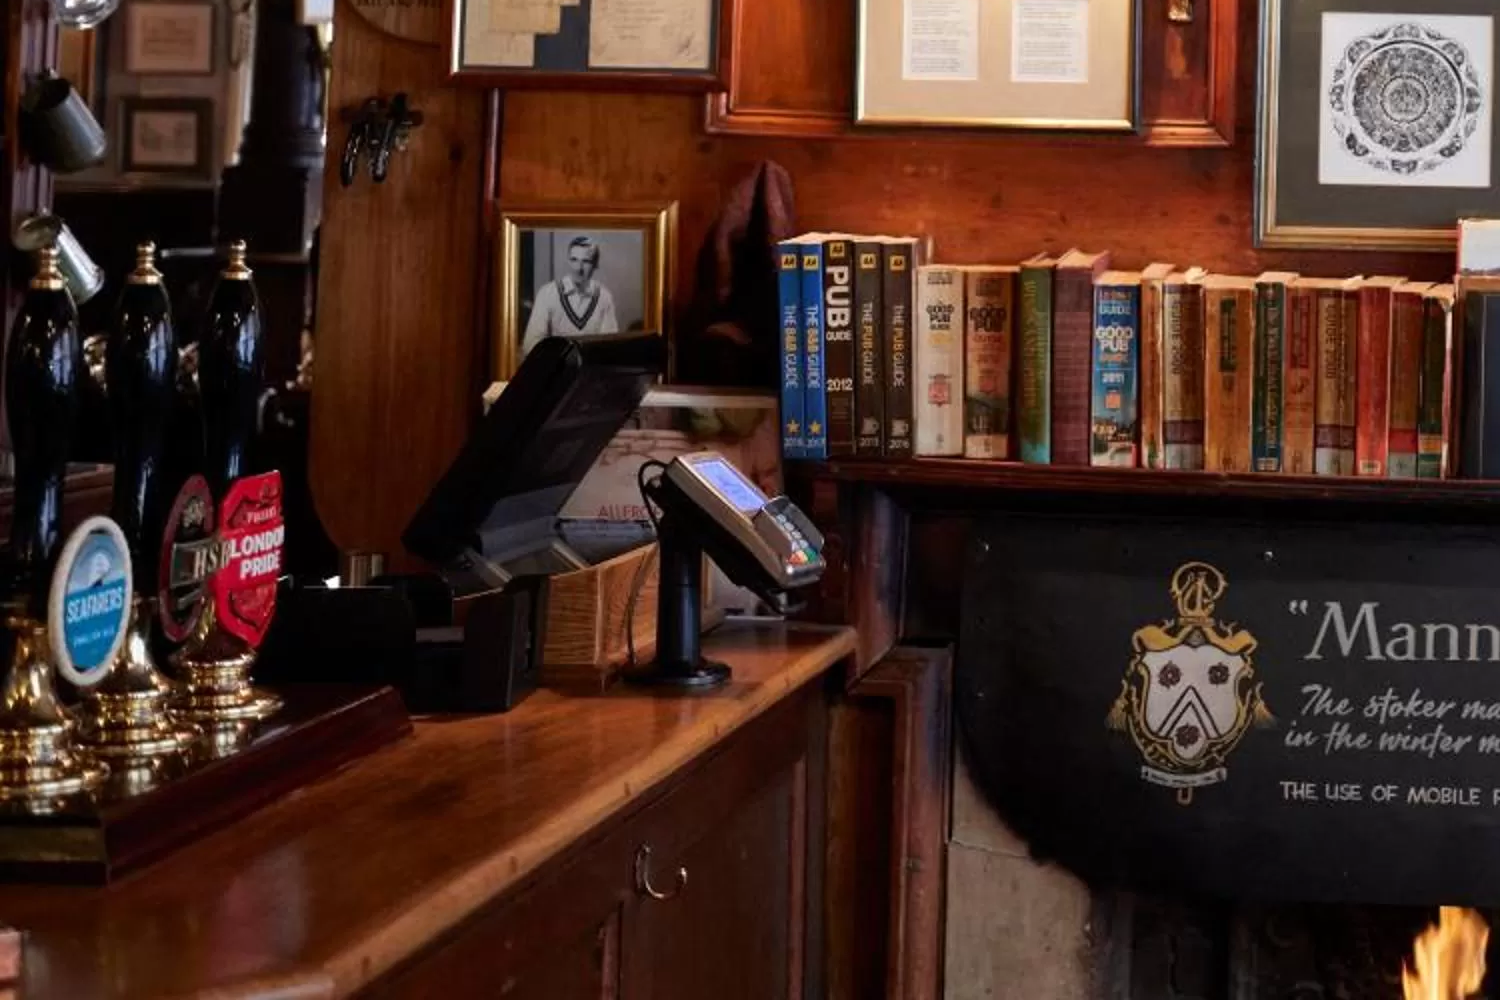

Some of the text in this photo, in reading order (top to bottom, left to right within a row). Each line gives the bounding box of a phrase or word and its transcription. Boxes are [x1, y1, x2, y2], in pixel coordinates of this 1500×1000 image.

[825, 265, 850, 329] PUB
[805, 305, 819, 327] THE
[1096, 326, 1134, 339] GOOD
[862, 301, 874, 386] THE PUB GUIDE
[892, 304, 905, 388] THE PUB GUIDE
[1100, 338, 1129, 352] PUB
[785, 353, 799, 389] GUIDE
[808, 355, 821, 389] GUIDE
[826, 378, 853, 391] 2012
[240, 550, 280, 580] PRIDE
[66, 586, 123, 625] SEAFARERS
[1300, 683, 1355, 719] The
[1363, 687, 1457, 726] stoker
[1284, 720, 1319, 749] in
[1323, 721, 1373, 756] the
[1379, 723, 1474, 756] winter
[1280, 780, 1318, 801] THE
[1325, 783, 1363, 803] USE
[1370, 784, 1400, 804] OF
[1406, 786, 1481, 807] MOBILE
